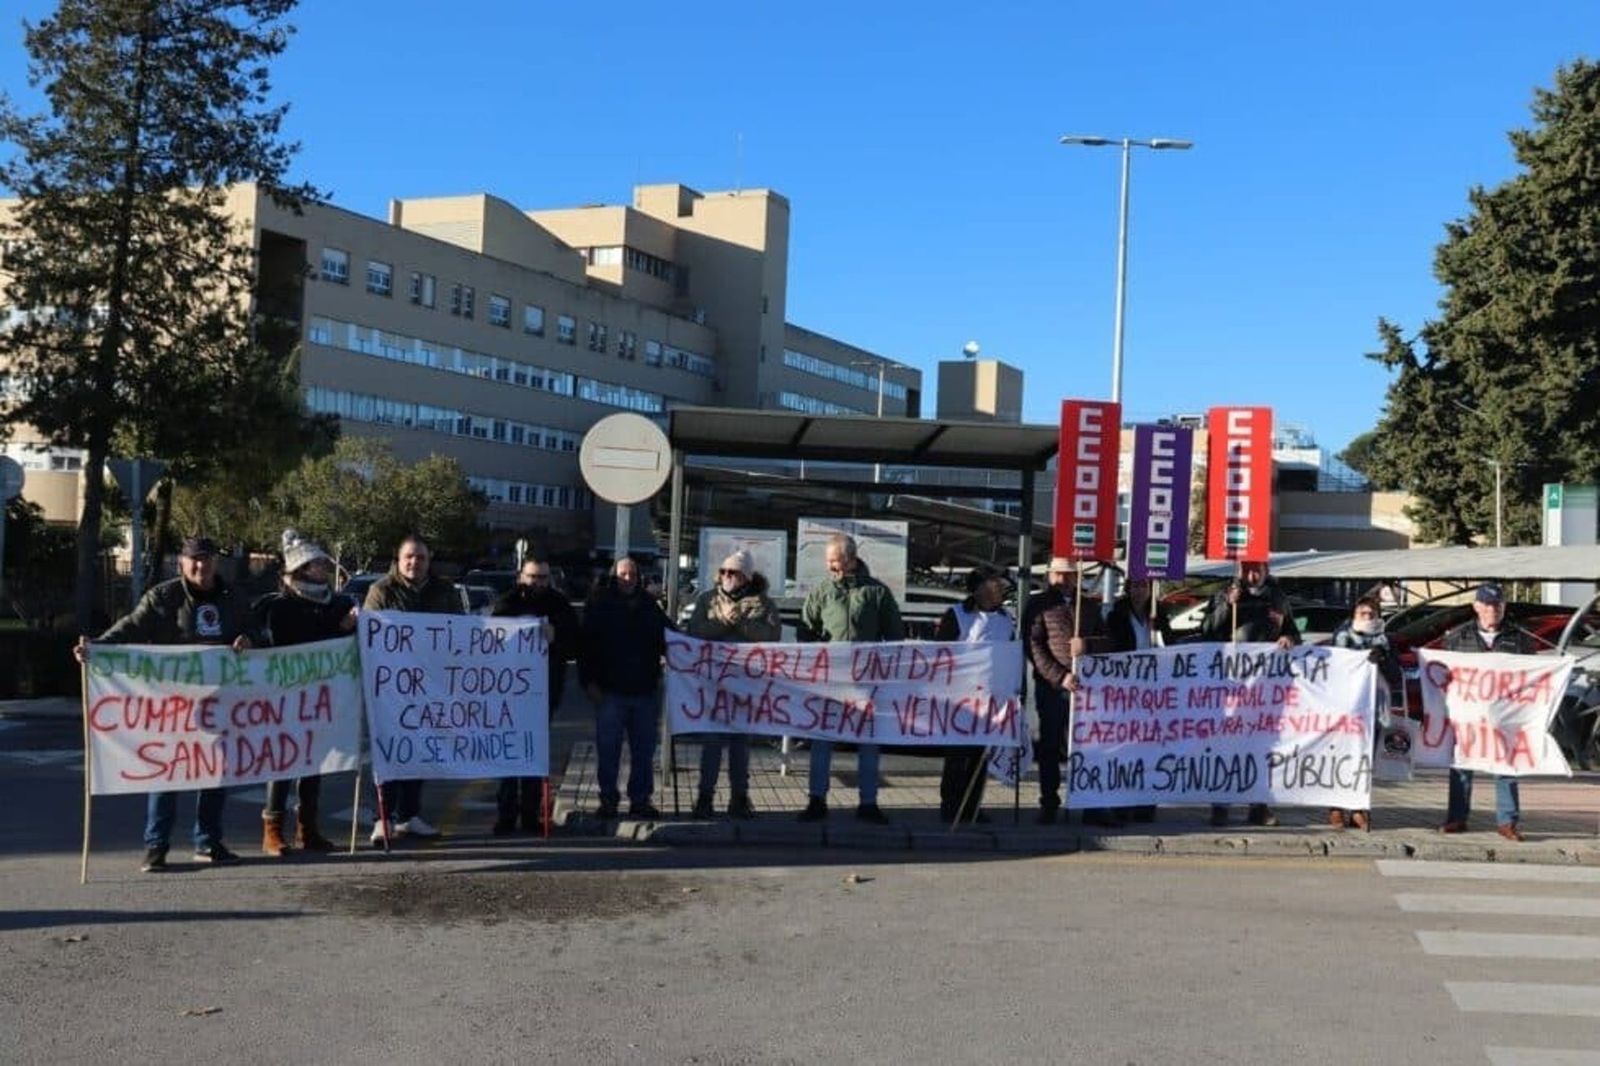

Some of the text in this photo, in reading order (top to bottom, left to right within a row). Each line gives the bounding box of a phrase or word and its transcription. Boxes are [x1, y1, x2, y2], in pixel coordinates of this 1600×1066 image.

[368, 618, 414, 652] POR
[470, 627, 506, 655] POR
[94, 651, 205, 685] JUNTA
[220, 655, 253, 685] DE
[665, 641, 958, 686] CAZORLA UNIDA
[1082, 653, 1158, 680] JUNTA
[1172, 650, 1199, 678] DE
[375, 665, 531, 697] POR TODOS
[91, 684, 332, 733] CUMPLE CON LA
[400, 699, 513, 730] CAZORLA
[681, 681, 791, 728] JAMÁS
[799, 686, 875, 738] SERÁ
[1102, 685, 1178, 714] PARQUE
[1187, 684, 1266, 711] NATURAL
[1271, 683, 1300, 707] DE
[420, 736, 446, 763] SE
[1107, 757, 1144, 790] UNA
[1152, 748, 1258, 793] SANIDAD
